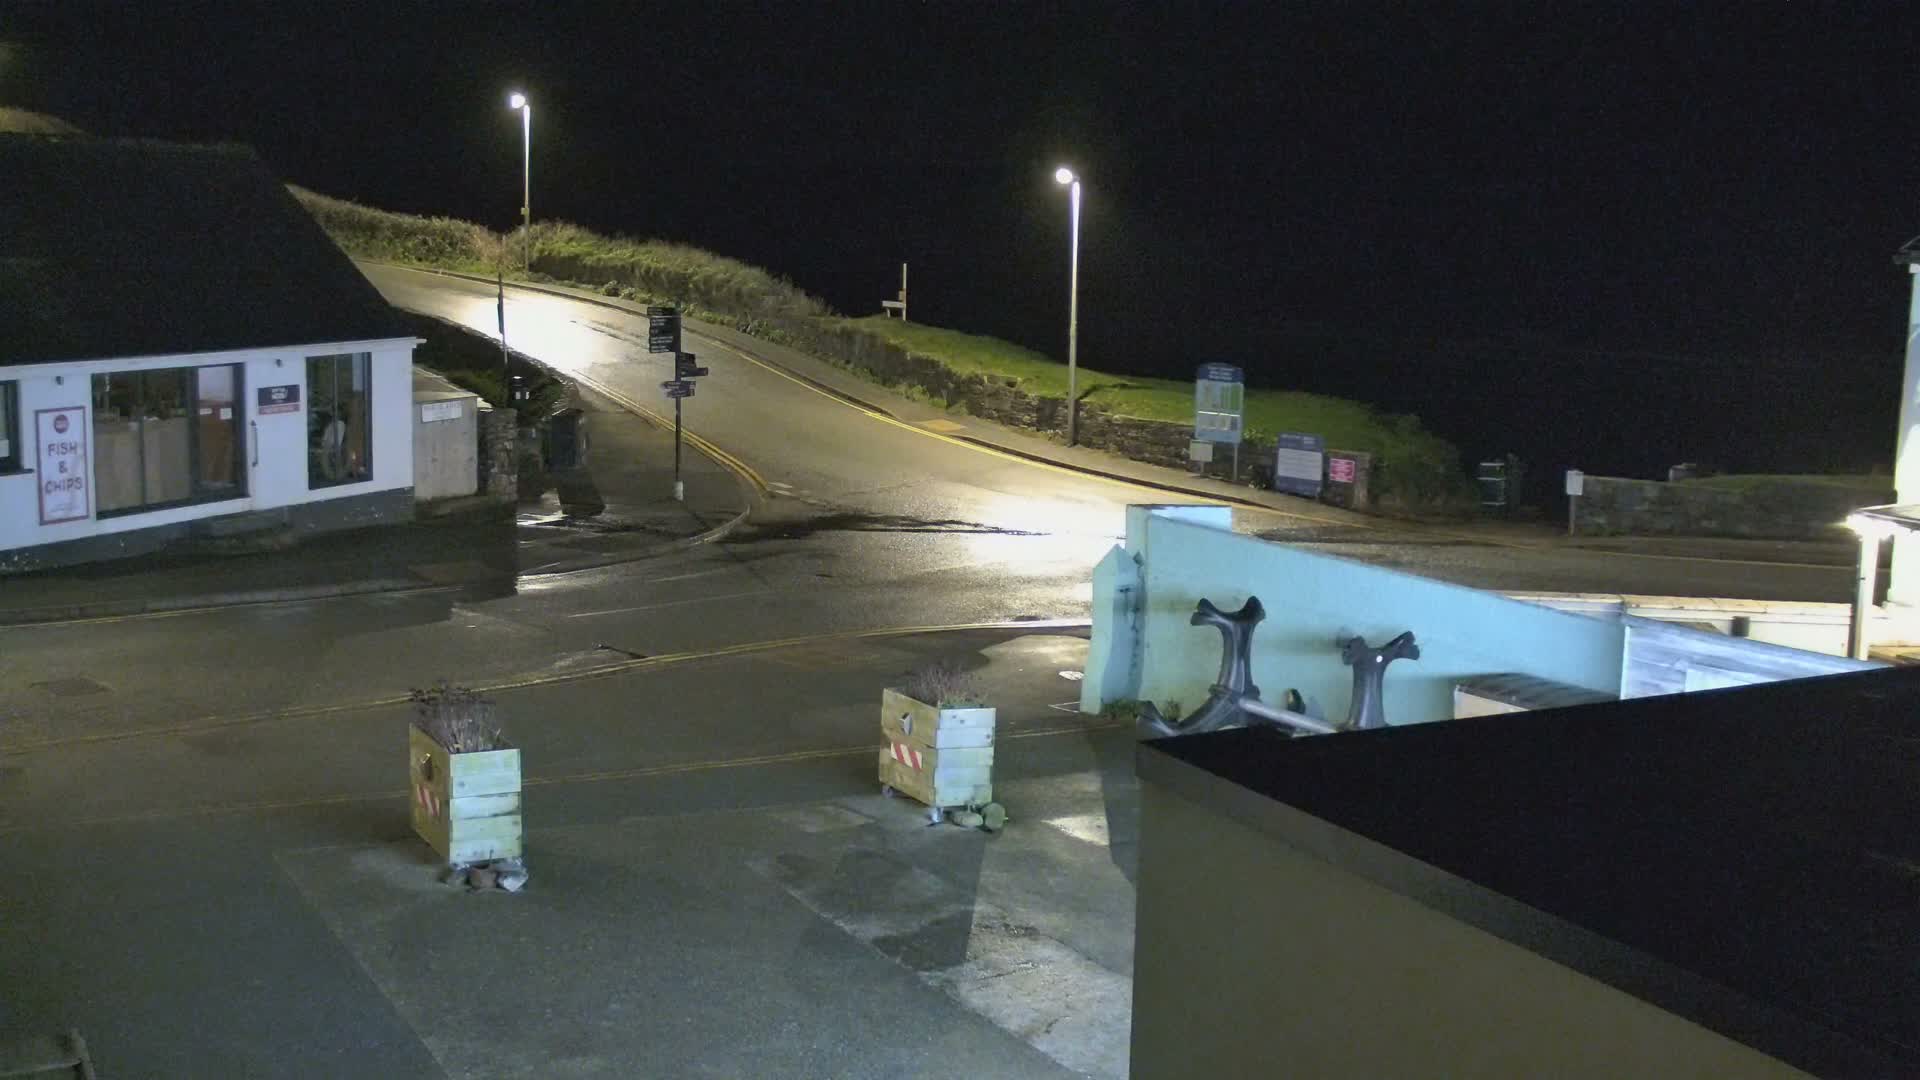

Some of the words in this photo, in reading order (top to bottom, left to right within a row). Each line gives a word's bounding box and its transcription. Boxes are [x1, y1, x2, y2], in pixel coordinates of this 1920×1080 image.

[47, 442, 78, 457] FISH
[59, 461, 69, 474] &
[45, 478, 83, 494] CHIPS
